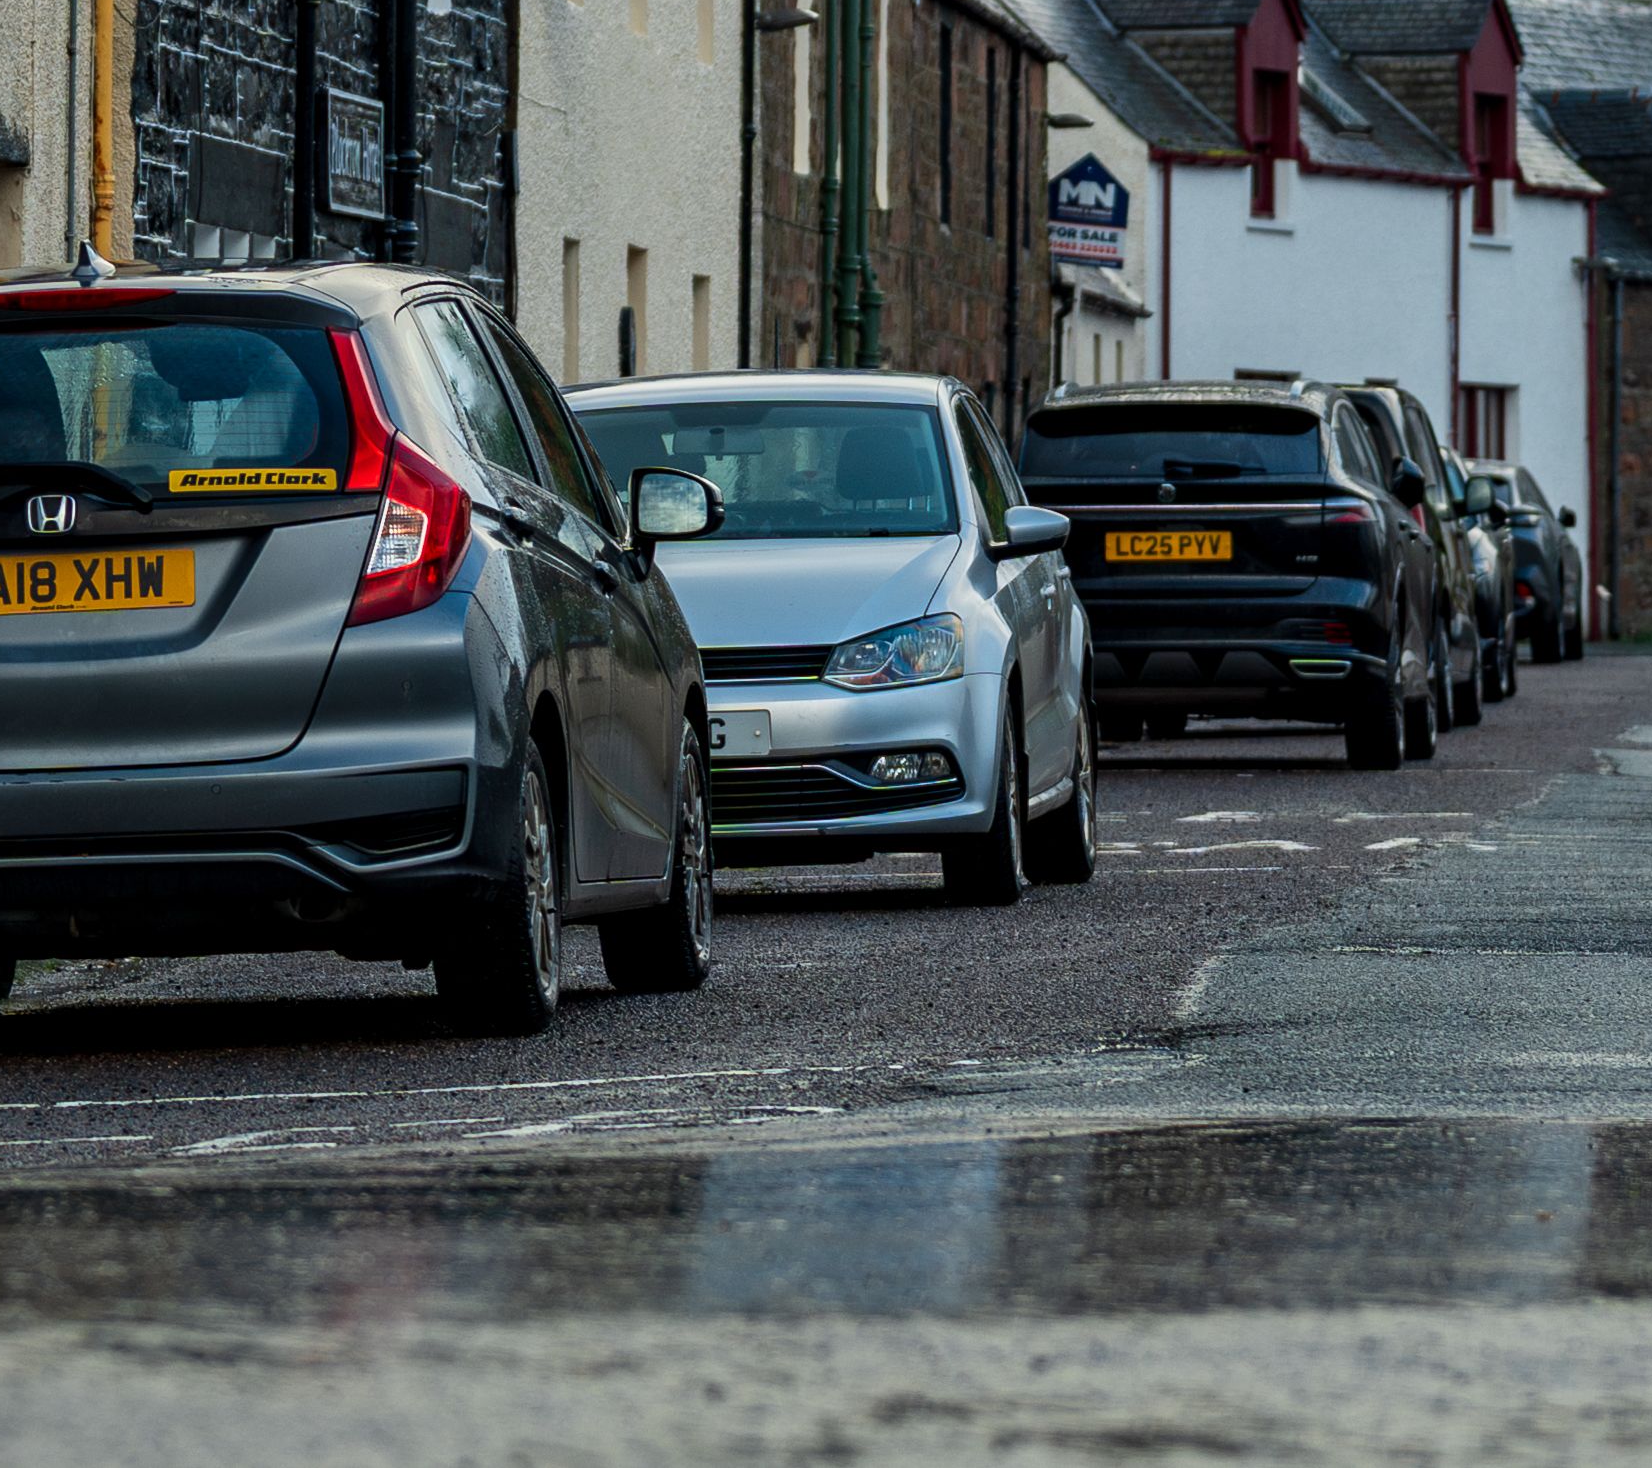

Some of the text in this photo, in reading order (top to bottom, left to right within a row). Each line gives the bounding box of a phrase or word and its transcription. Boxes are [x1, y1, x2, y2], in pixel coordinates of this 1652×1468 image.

[1048, 225, 1118, 243] FOR SALE
[180, 473, 326, 486] Arnold Clark
[1116, 535, 1221, 556] LC25 PYV
[73, 555, 164, 601] XHW
